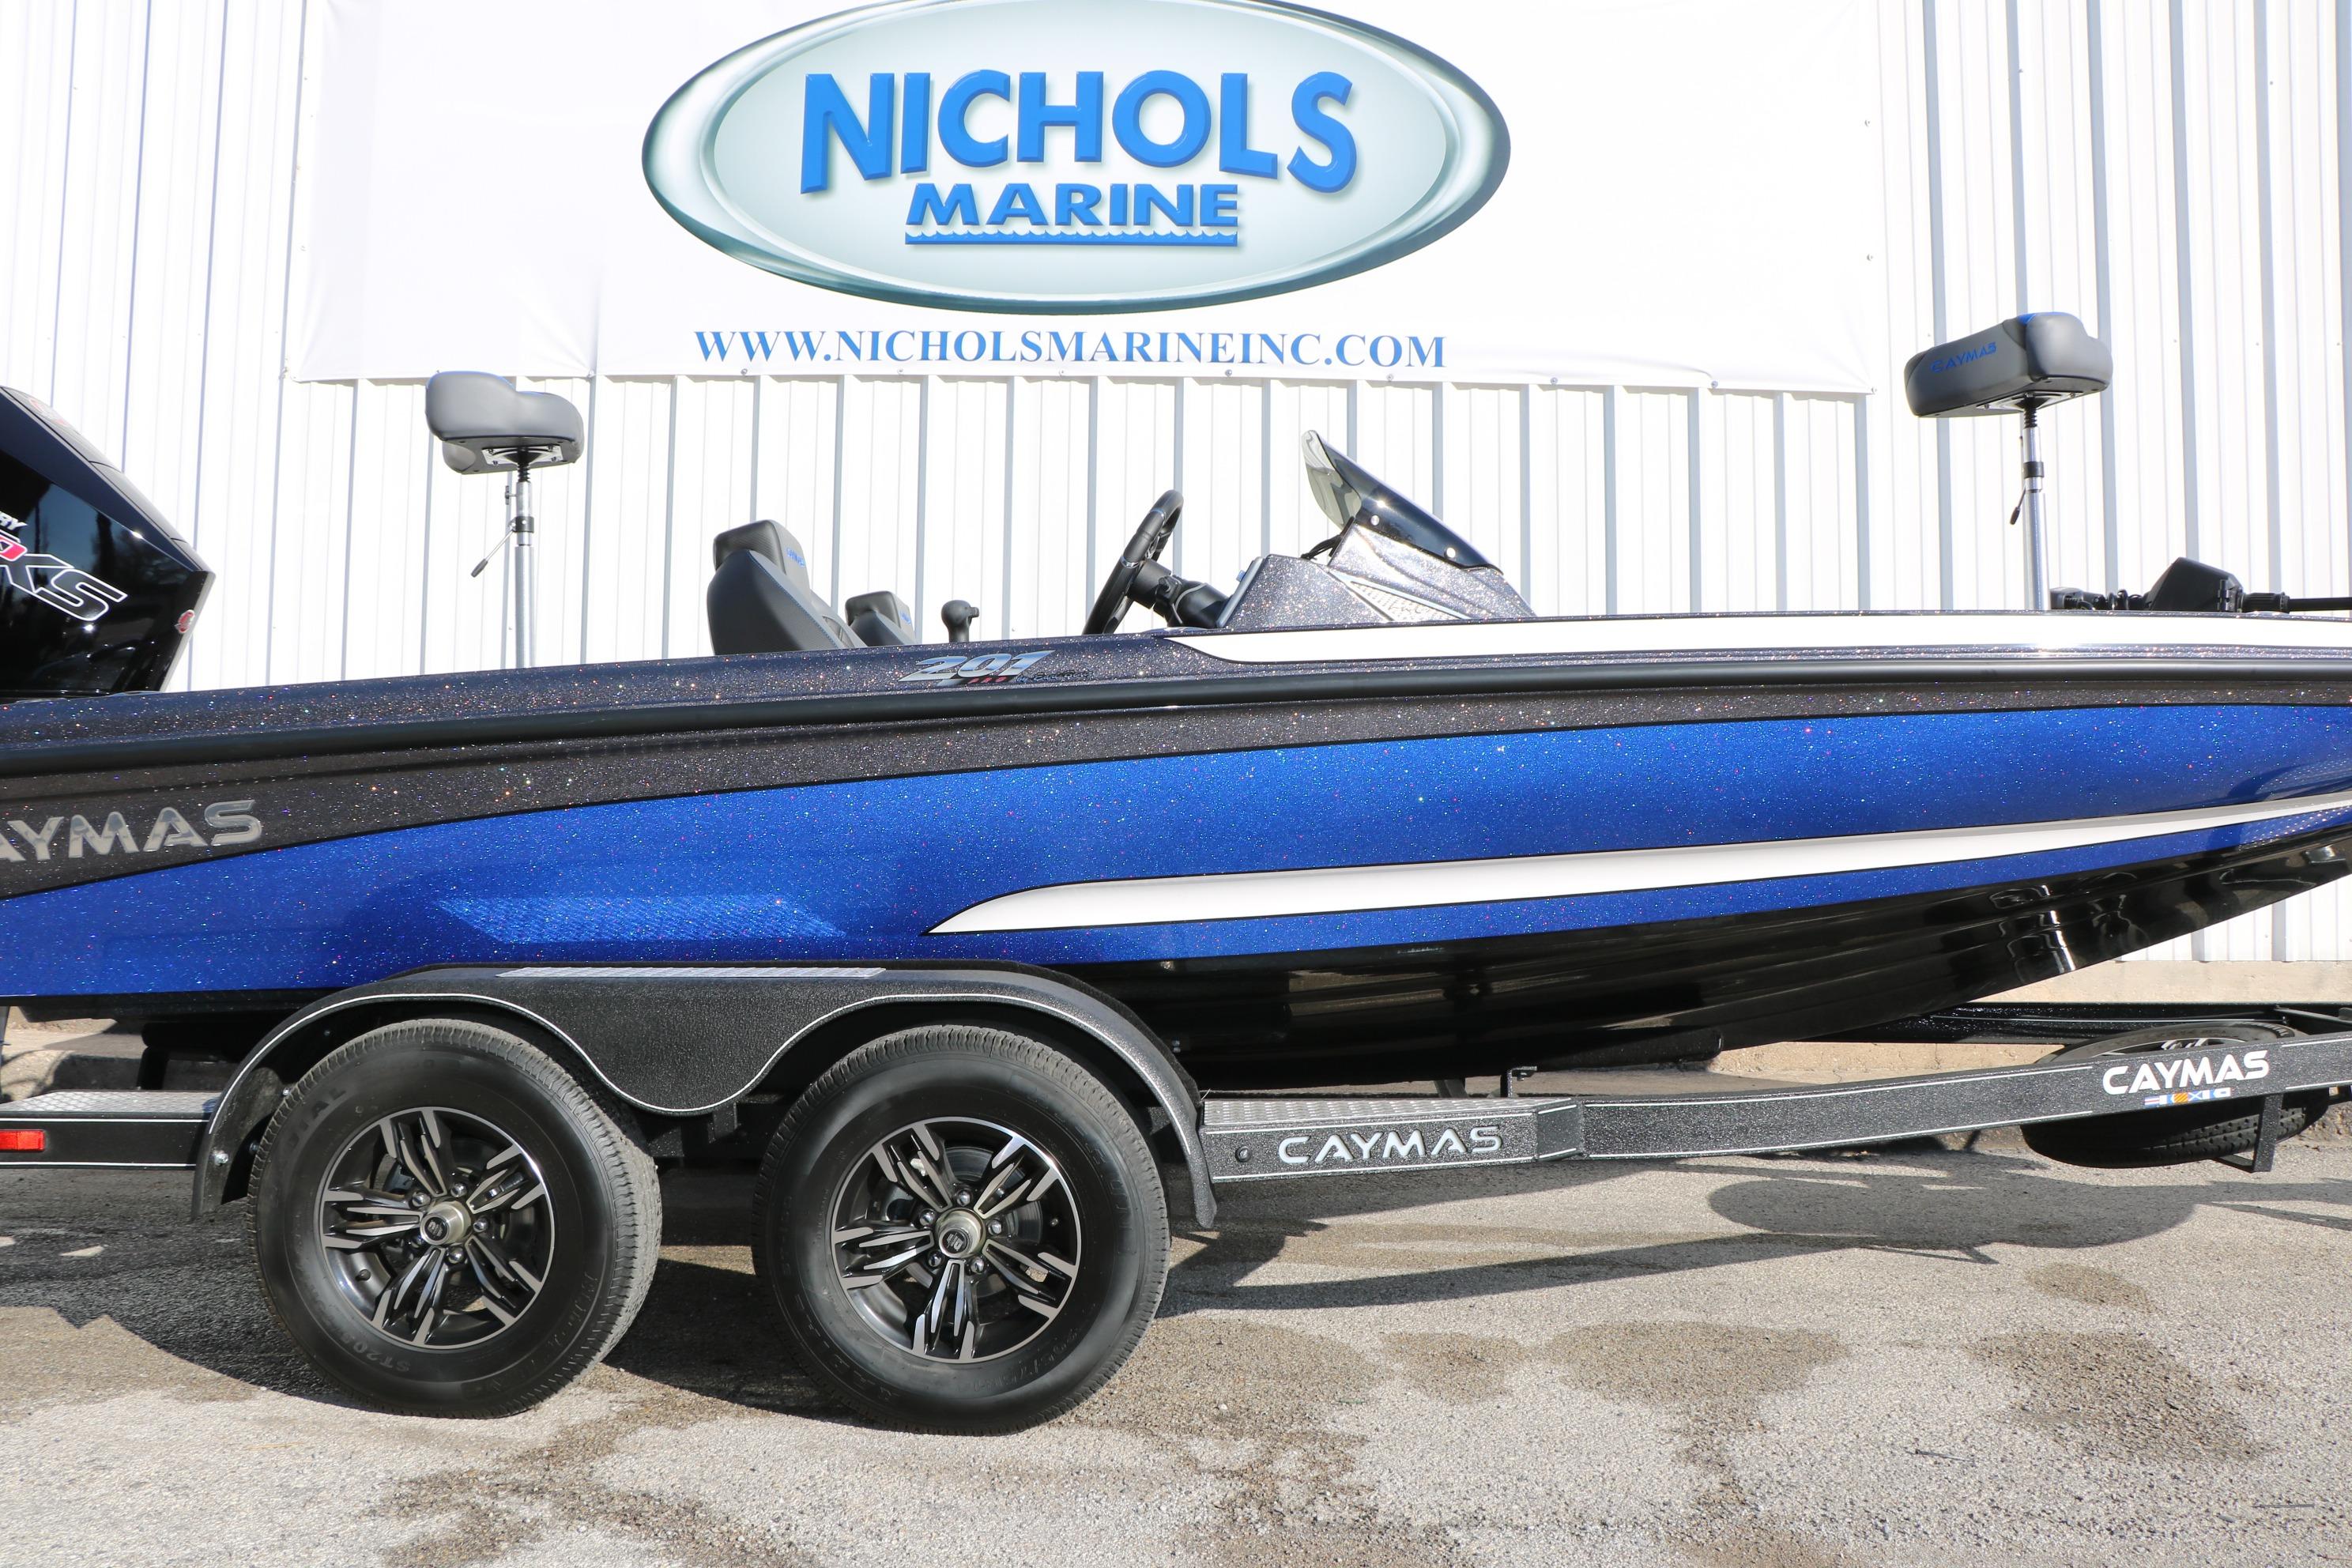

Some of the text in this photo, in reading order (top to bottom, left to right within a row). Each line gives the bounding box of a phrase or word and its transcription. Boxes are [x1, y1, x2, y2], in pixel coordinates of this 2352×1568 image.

[801, 69, 1358, 195] NICHOLS
[906, 183, 1238, 228] MARINE
[694, 330, 1447, 368] WWW.NICHOLSMARINEINC.COM
[1931, 341, 1997, 373] CAYMAS
[898, 650, 1056, 682] 201
[2102, 1050, 2270, 1095] CAYMAS
[1277, 1125, 1503, 1163] CAYMAS
